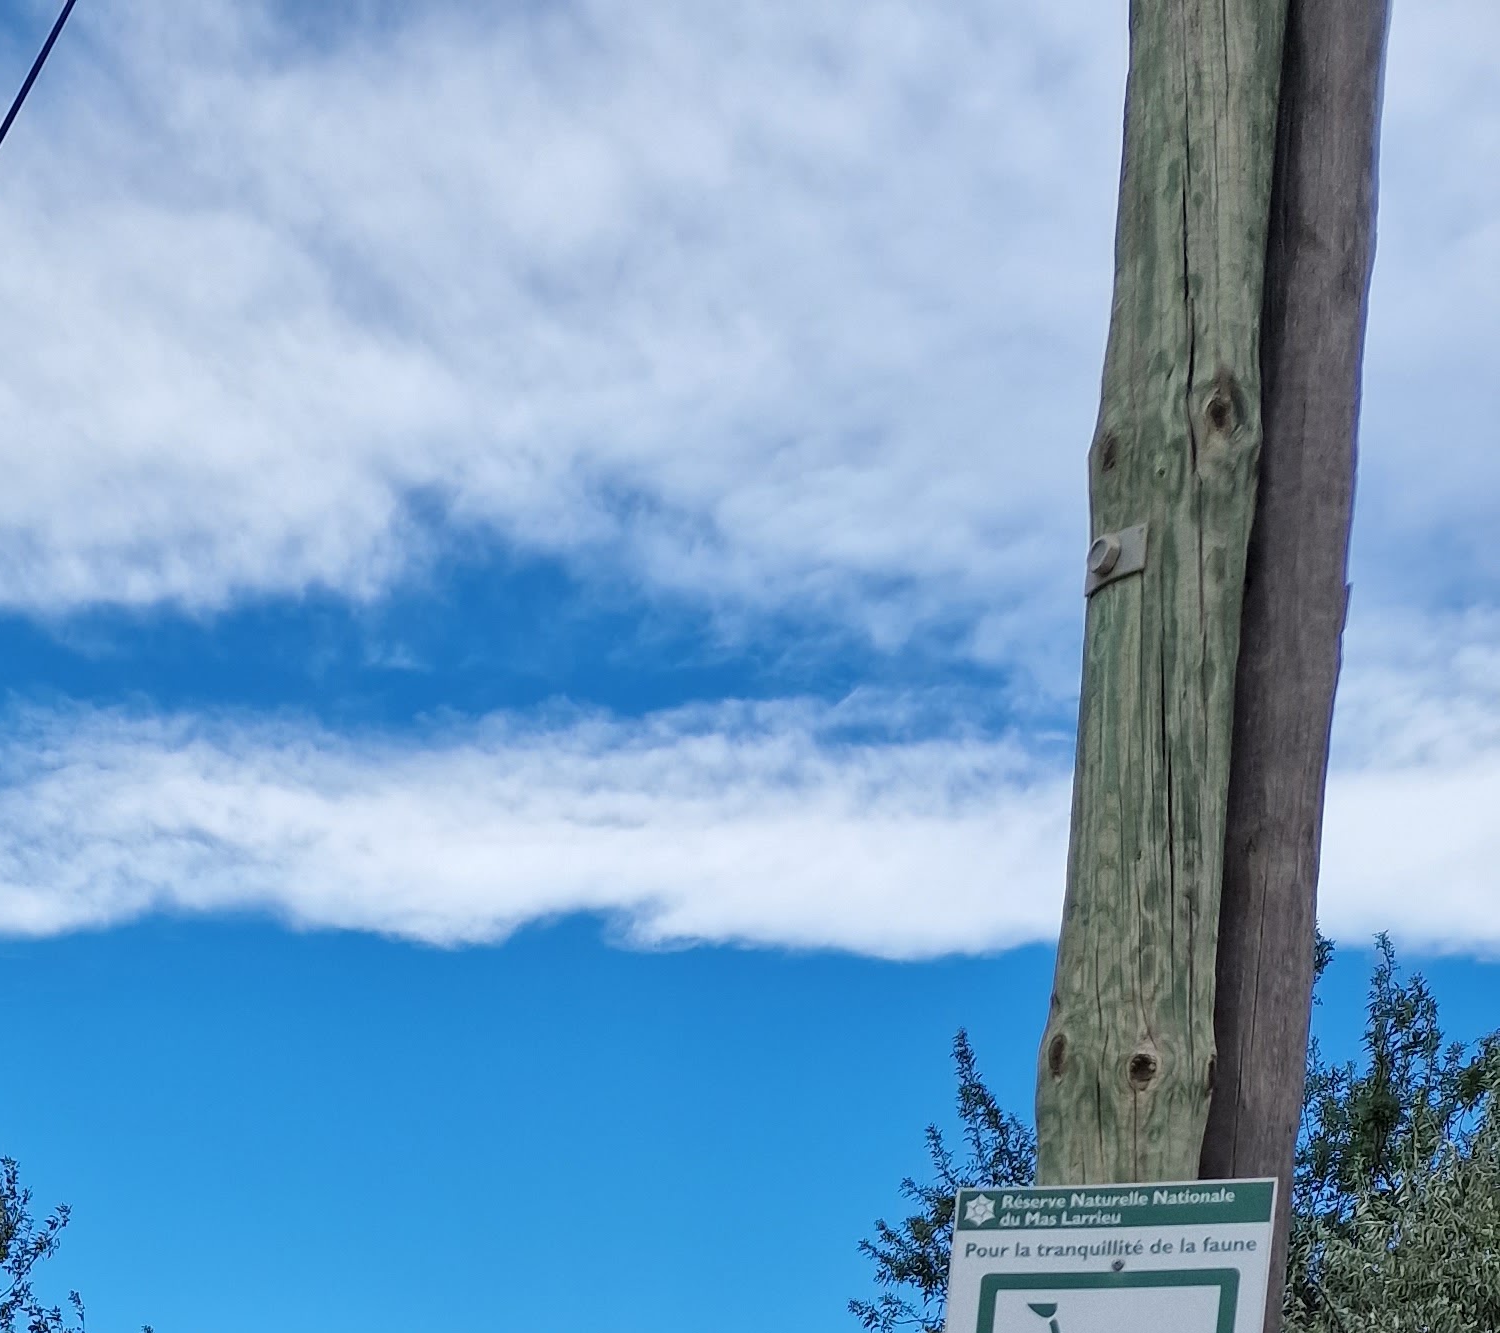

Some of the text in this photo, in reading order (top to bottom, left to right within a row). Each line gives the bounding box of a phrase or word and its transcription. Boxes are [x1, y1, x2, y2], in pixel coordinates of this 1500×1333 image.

[1001, 1188, 1235, 1210] Réserve Naturelle Nationale
[1000, 1210, 1121, 1227] du Mas Larrieu
[965, 1236, 1257, 1261] Pour la tranquillité de la faune
